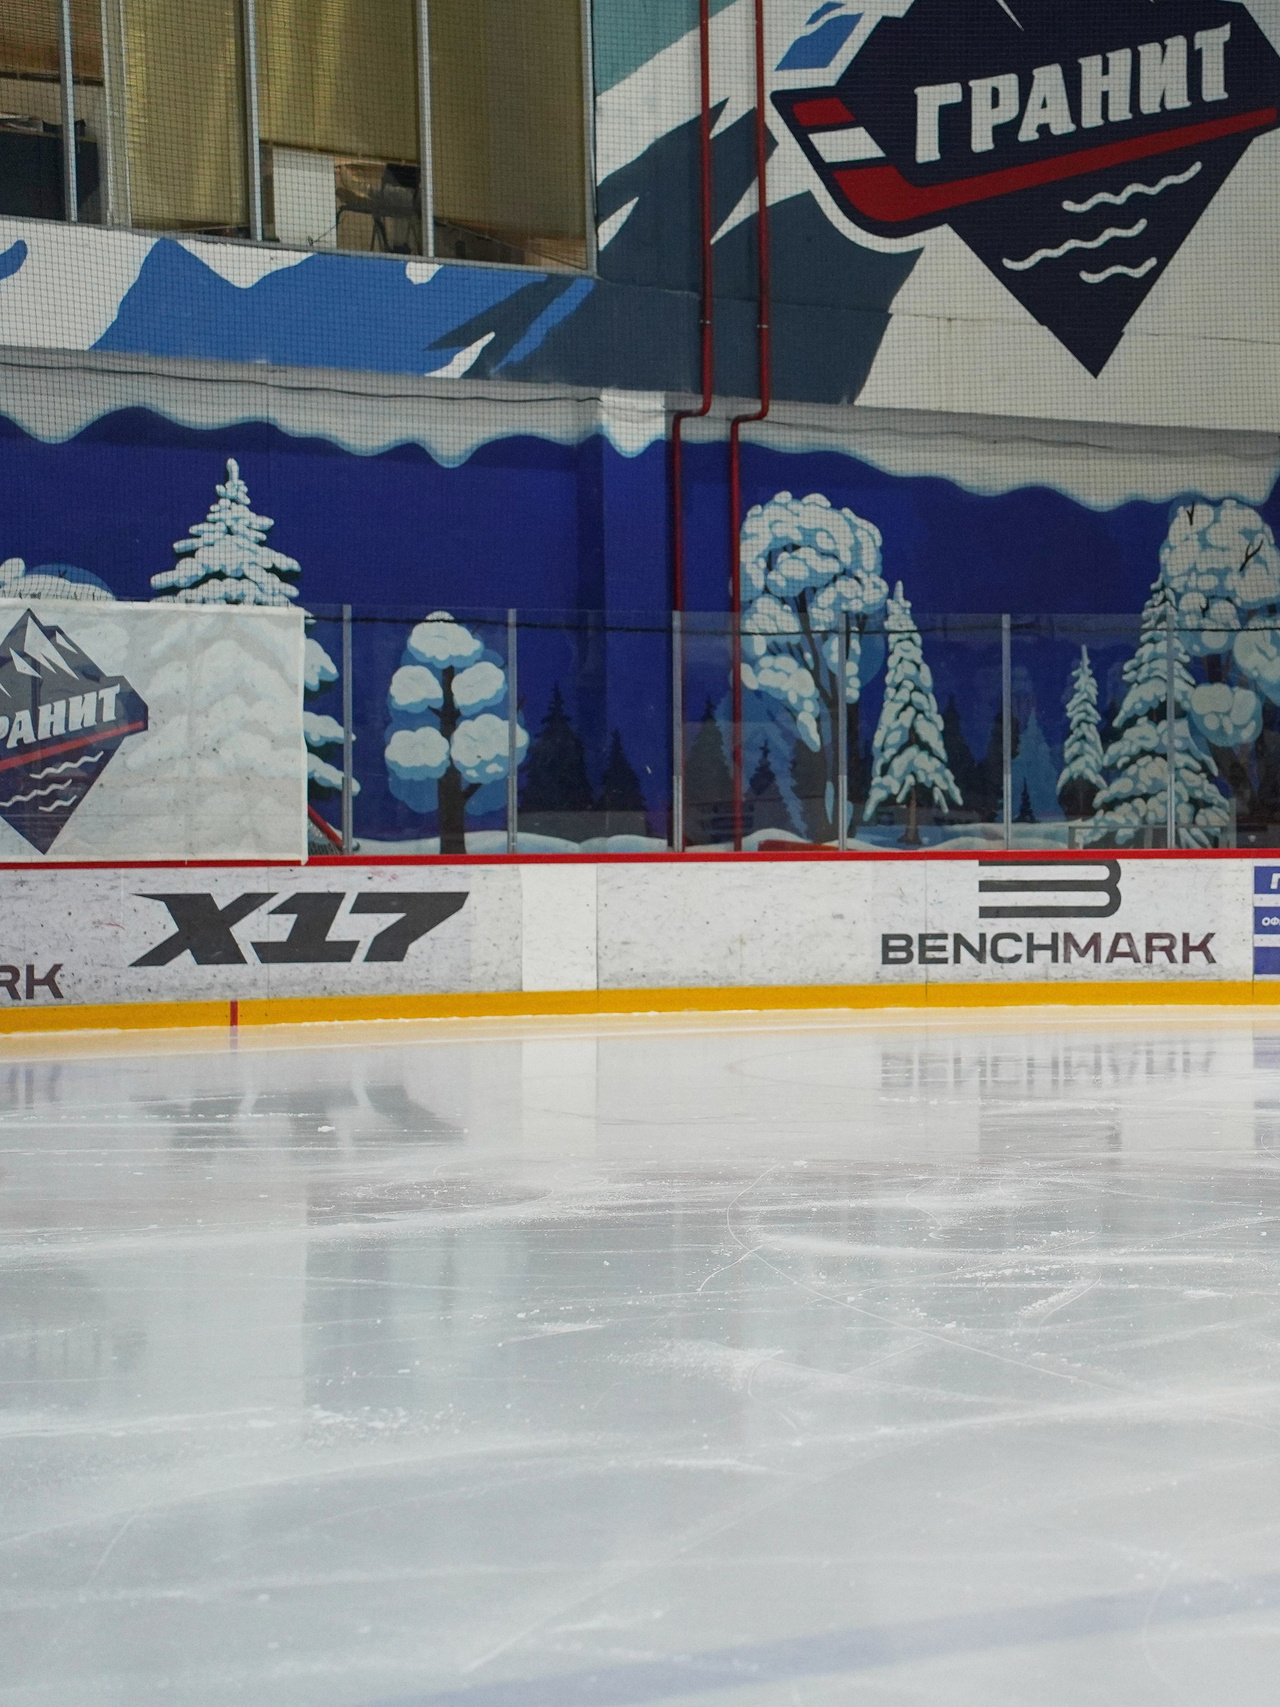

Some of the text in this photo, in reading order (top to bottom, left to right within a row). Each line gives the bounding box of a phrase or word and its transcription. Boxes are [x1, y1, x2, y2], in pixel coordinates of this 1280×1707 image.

[914, 21, 1231, 164] ГРАНИТ
[128, 891, 470, 967] X17
[881, 932, 1216, 965] BENCHMARK
